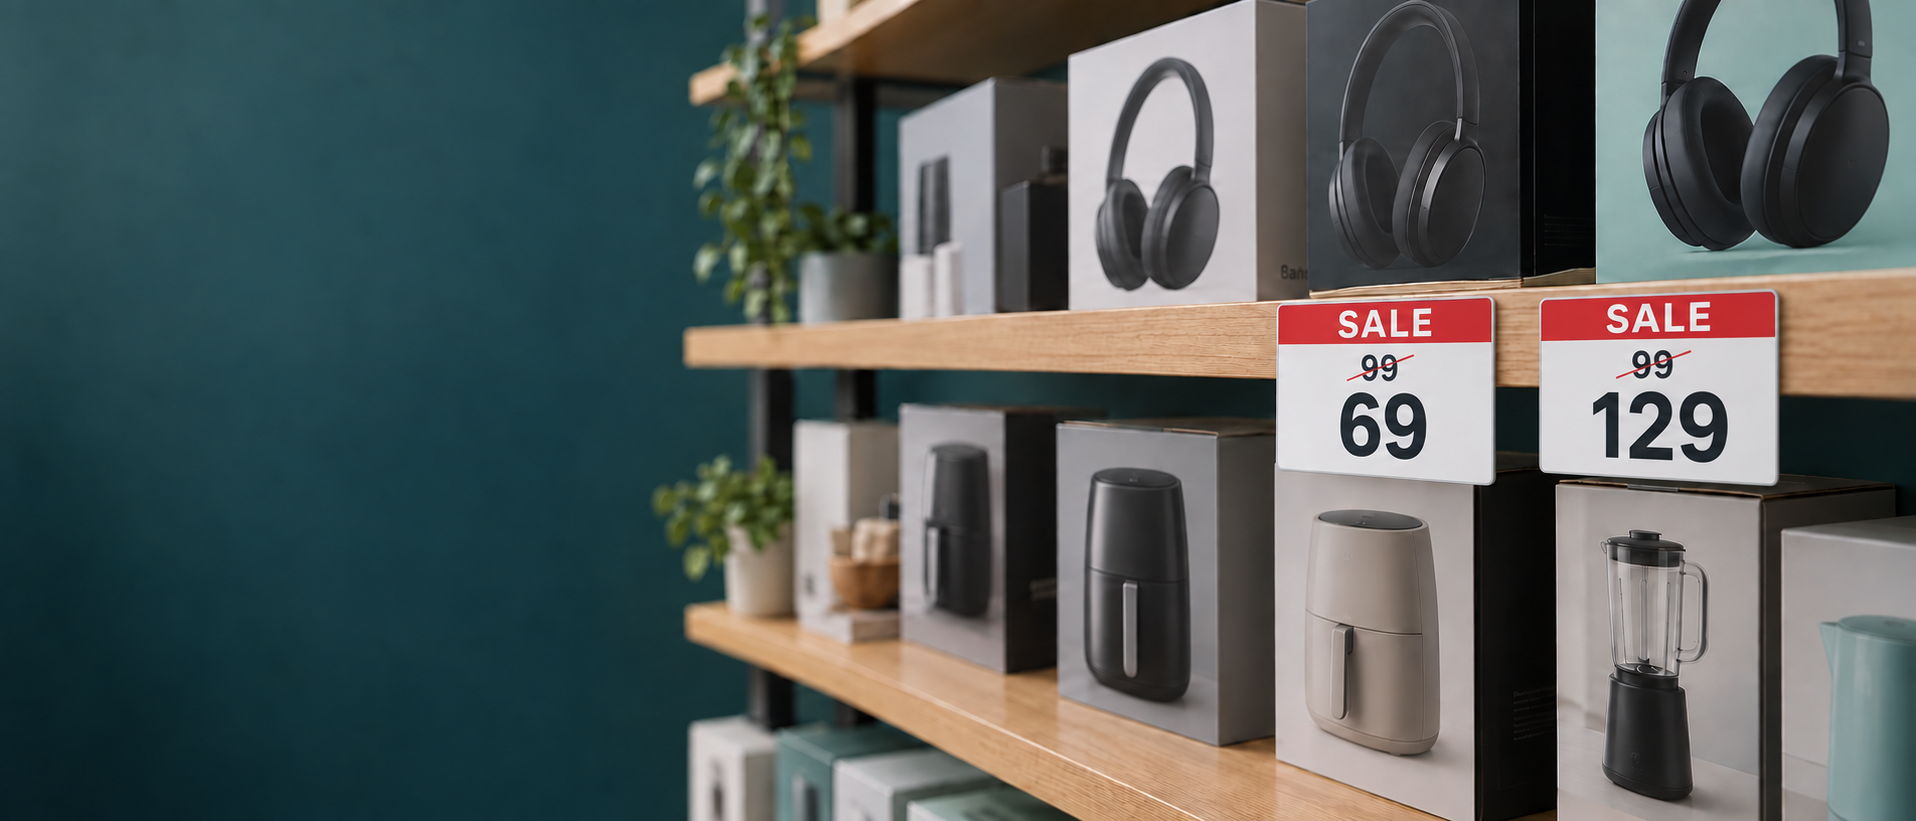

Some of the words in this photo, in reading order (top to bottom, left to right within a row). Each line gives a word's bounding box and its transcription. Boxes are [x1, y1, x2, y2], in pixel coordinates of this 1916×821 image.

[1338, 307, 1432, 338] SALE
[1607, 302, 1711, 334] SALE
[1361, 354, 1398, 382] 99
[1632, 350, 1673, 379] 99
[1340, 392, 1427, 460] 69
[1592, 391, 1728, 463] 129
